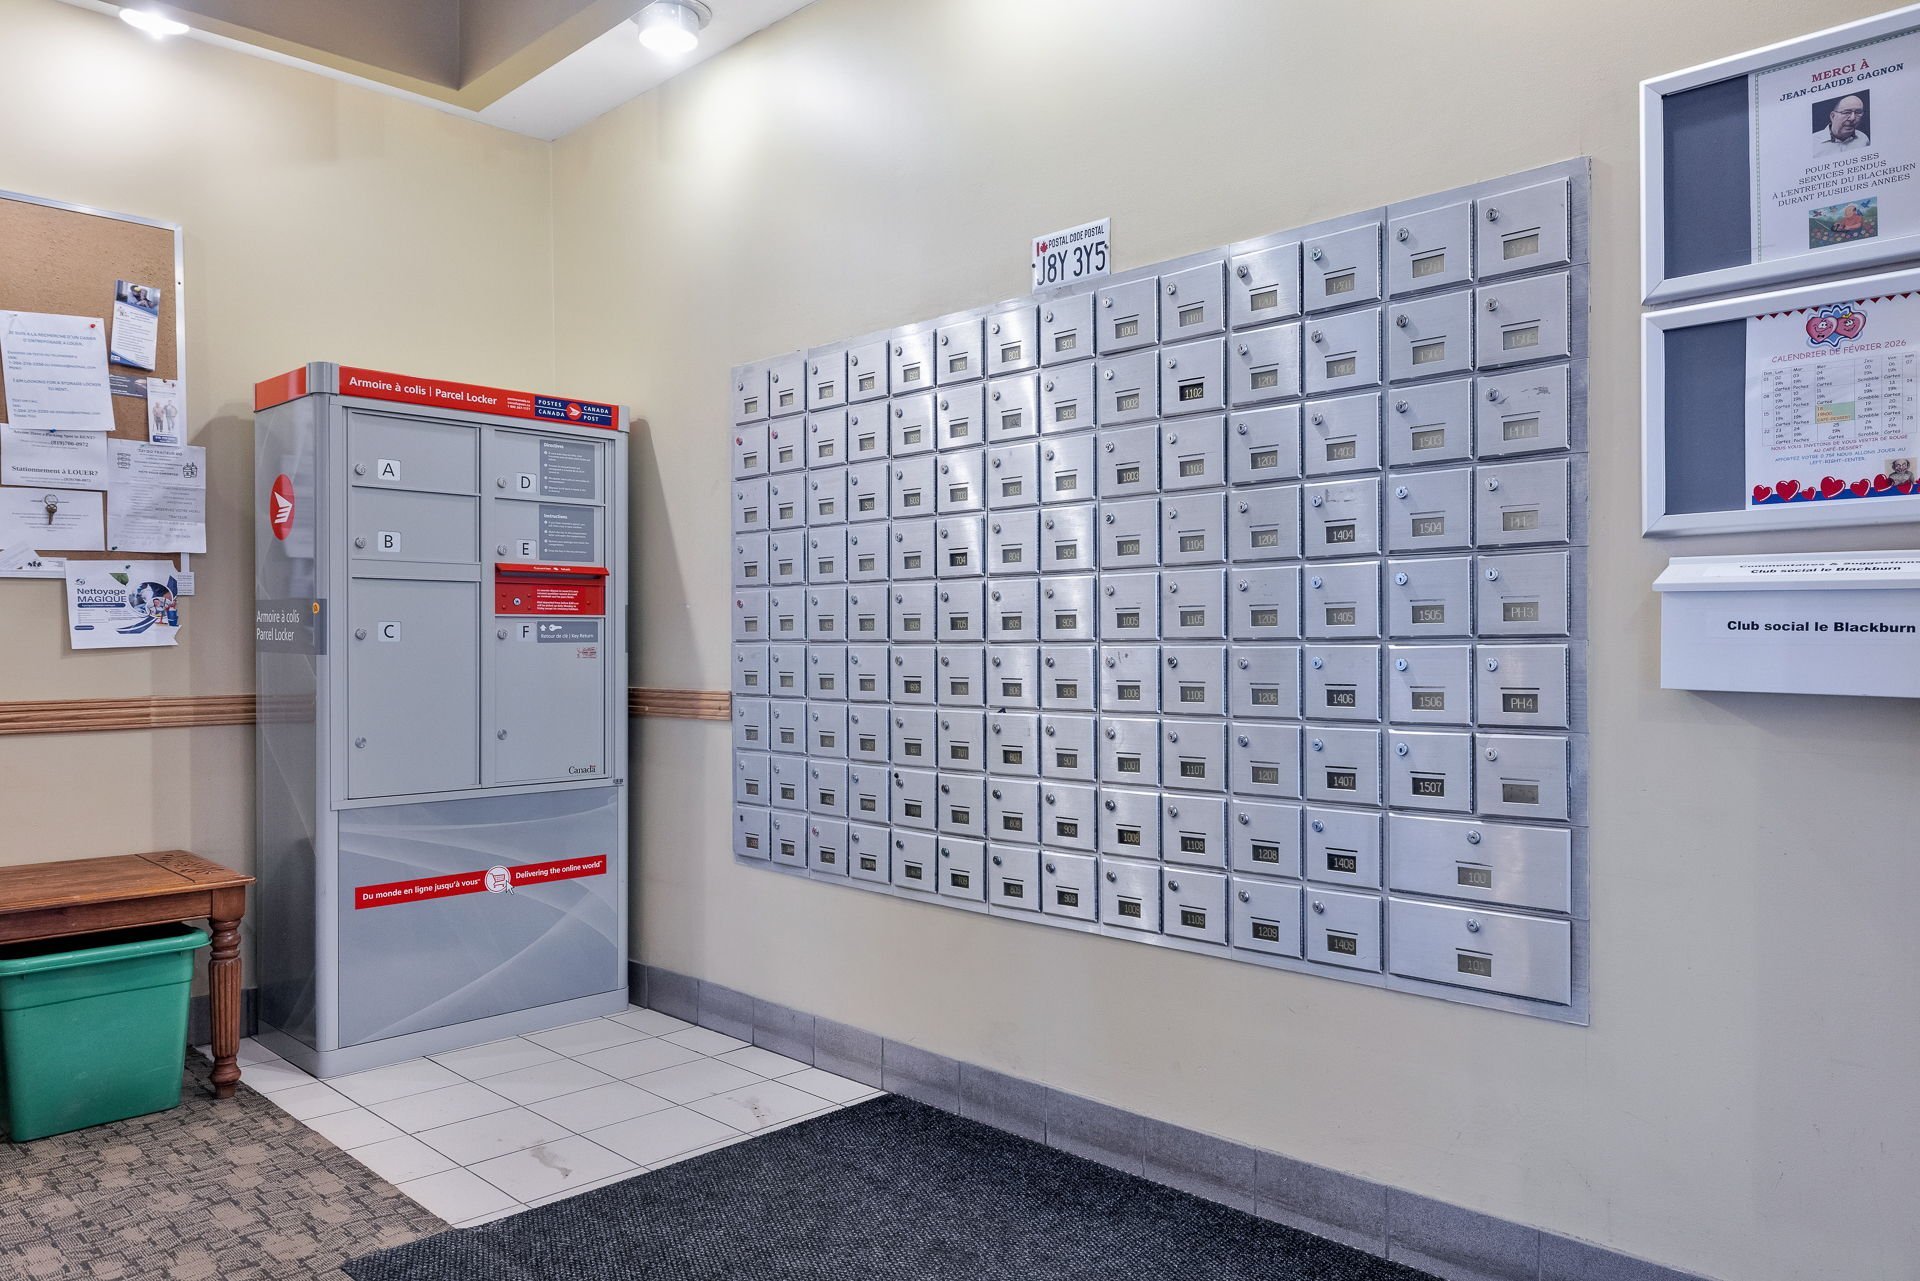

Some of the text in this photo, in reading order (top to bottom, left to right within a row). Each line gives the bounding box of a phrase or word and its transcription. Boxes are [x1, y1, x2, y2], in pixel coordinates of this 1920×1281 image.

[1811, 59, 1870, 83] MERCI À
[1780, 62, 1904, 102] JEAN-CLAUDE GAGNON
[1805, 153, 1880, 174] POUR TOUS SES
[1799, 160, 1887, 185] SERVICES RENDUS
[1772, 163, 1916, 200] À L'ENTRETIEN DU BLACKBURN
[1778, 173, 1911, 207] DURANT PLUSIEURS ANNÉES
[1048, 225, 1104, 249] POSTAL CODE POSTAL
[1037, 240, 1106, 285] J8Y 3Y5
[1772, 350, 1826, 363] CALENDRIER
[1843, 343, 1881, 353] FÉVRIER
[1885, 339, 1907, 348] 2026
[349, 376, 392, 391] Armoire
[395, 382, 401, 392] à
[404, 385, 426, 396] colis
[435, 388, 464, 402] Parcel
[466, 393, 497, 406] Locker
[1185, 388, 1202, 399] 1102
[538, 409, 565, 417] CANADA
[583, 406, 609, 414] CANADA
[1257, 456, 1276, 466] 1203
[11, 466, 60, 474] Stationnement
[382, 463, 395, 477] A
[1185, 464, 1203, 474] 1103
[1123, 471, 1139, 481] 1003
[521, 476, 531, 489] D
[1420, 521, 1442, 534] 1504
[384, 534, 393, 548] B
[1258, 534, 1277, 544] 1204
[1333, 530, 1353, 541] 1404
[522, 543, 529, 556] E
[1186, 540, 1203, 550] 1104
[956, 555, 966, 564] 704
[77, 588, 126, 596] Nettoyage
[256, 610, 300, 623] Armoire à colis
[1186, 615, 1203, 624] 1105
[1258, 614, 1277, 624] 1205
[1333, 612, 1353, 623] 1405
[1420, 610, 1442, 620] 1505
[1122, 616, 1139, 626] 1005
[1727, 620, 1916, 633] Club social le Blackburn
[256, 628, 294, 641] Parcel Locker
[384, 624, 394, 638] C
[522, 626, 529, 638] F
[1123, 688, 1139, 698] 1006
[1186, 690, 1203, 700] 1106
[1258, 693, 1277, 702] 1206
[1333, 694, 1353, 704] 1406
[1420, 696, 1442, 707] 1506
[1511, 698, 1533, 709] PH4
[568, 765, 596, 775] Canada
[1186, 765, 1203, 775] 1107
[1258, 770, 1277, 781] 1207
[1334, 776, 1354, 787] 1407
[1419, 781, 1441, 793] 1507
[1123, 833, 1140, 842] 1008
[1187, 840, 1204, 850] 1108
[1258, 849, 1277, 861] 1208
[1334, 858, 1354, 870] 1408
[362, 893, 373, 901] Du
[375, 890, 402, 899] monde
[414, 883, 433, 895] ligne
[434, 880, 460, 892] jusqu'à
[515, 868, 548, 880] Delivering
[550, 866, 560, 874] the
[561, 864, 581, 872] online
[1187, 914, 1204, 925] 1109
[1258, 926, 1277, 938] 1209
[1334, 939, 1355, 951] 1409
